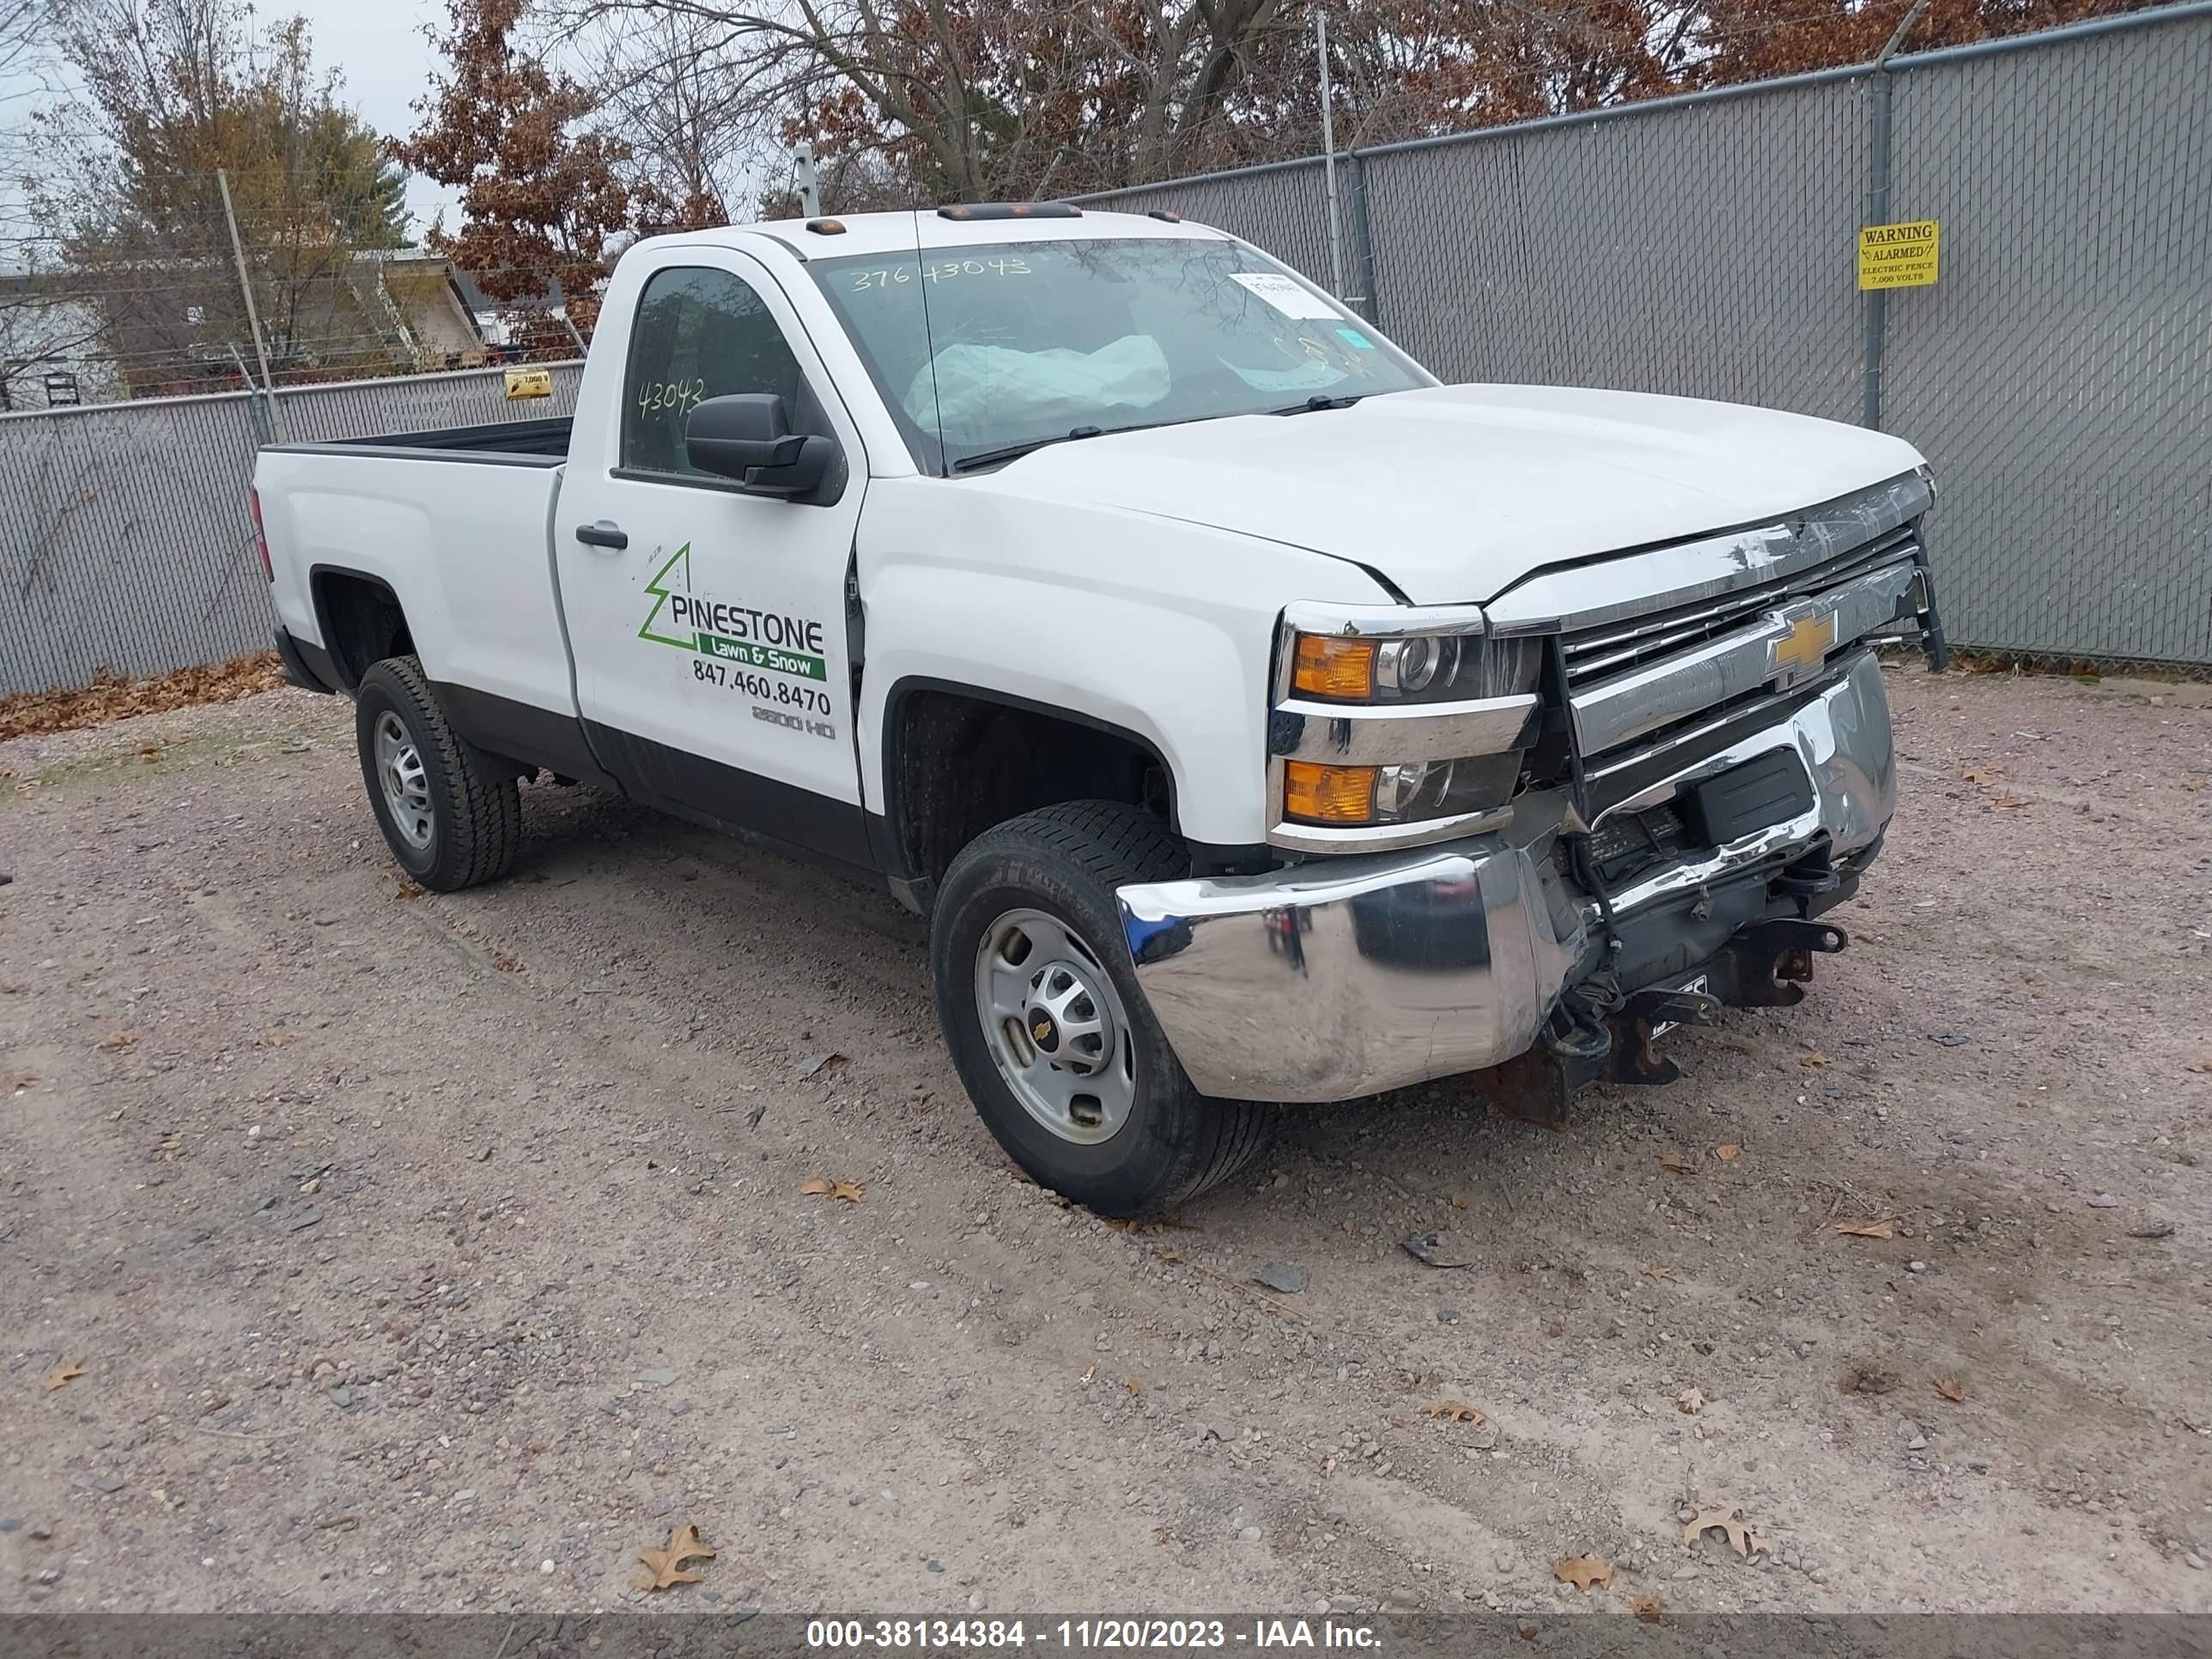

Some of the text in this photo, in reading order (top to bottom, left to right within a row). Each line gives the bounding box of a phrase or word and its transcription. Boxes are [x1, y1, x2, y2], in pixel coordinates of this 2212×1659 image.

[1865, 225, 1933, 244] WARNING
[1873, 246, 1923, 262] ALARMED
[850, 267, 910, 292] 376
[1863, 262, 1934, 275] ELECTRIC FENCE
[1896, 272, 1923, 282] VOLTS
[672, 594, 824, 655] PINESTONE
[711, 637, 811, 675] Lawn & Snow
[693, 659, 831, 716] 847.460.8470
[751, 706, 836, 740] 2500 HD
